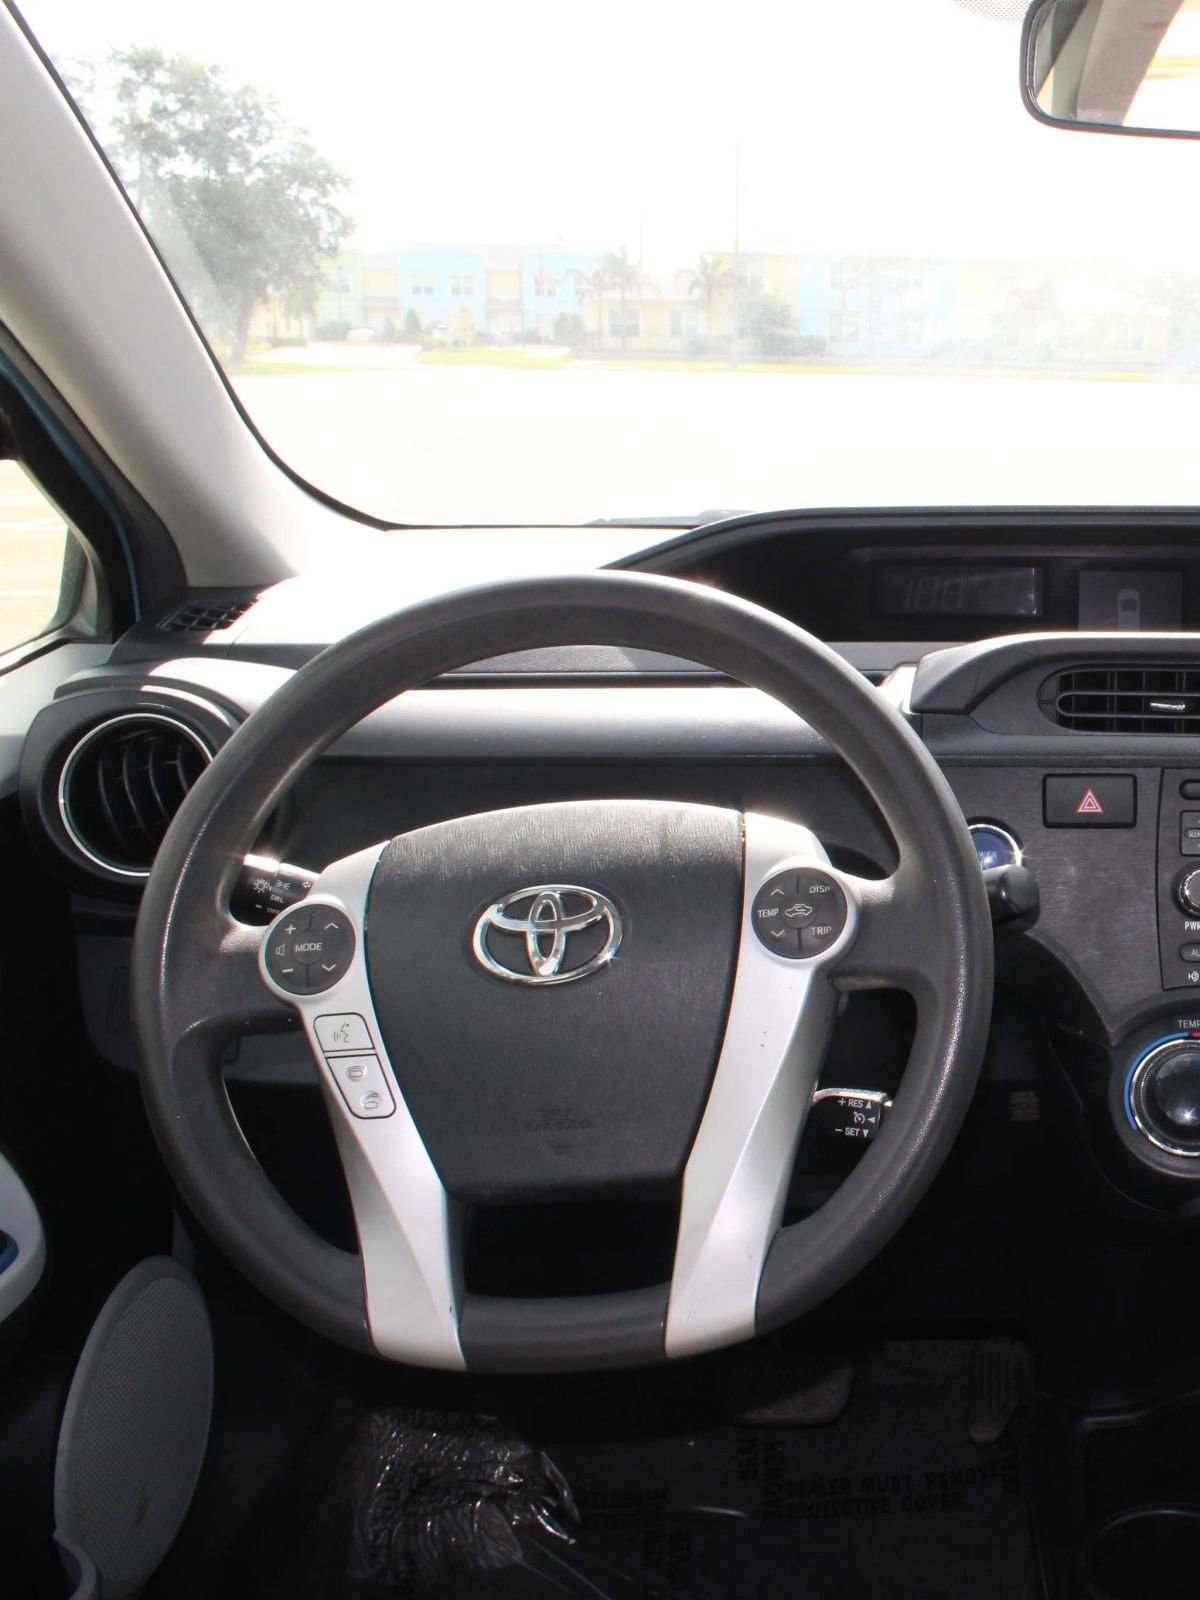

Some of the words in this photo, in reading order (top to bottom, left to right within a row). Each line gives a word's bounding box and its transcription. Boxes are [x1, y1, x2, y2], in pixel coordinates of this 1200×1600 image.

[809, 885, 831, 894] DISP
[757, 908, 779, 918] TEMP
[811, 926, 832, 936] TRIP
[295, 942, 323, 953] MODE
[847, 1099, 864, 1109] RES
[844, 1127, 861, 1137] SET
[861, 1473, 913, 1494] MUST
